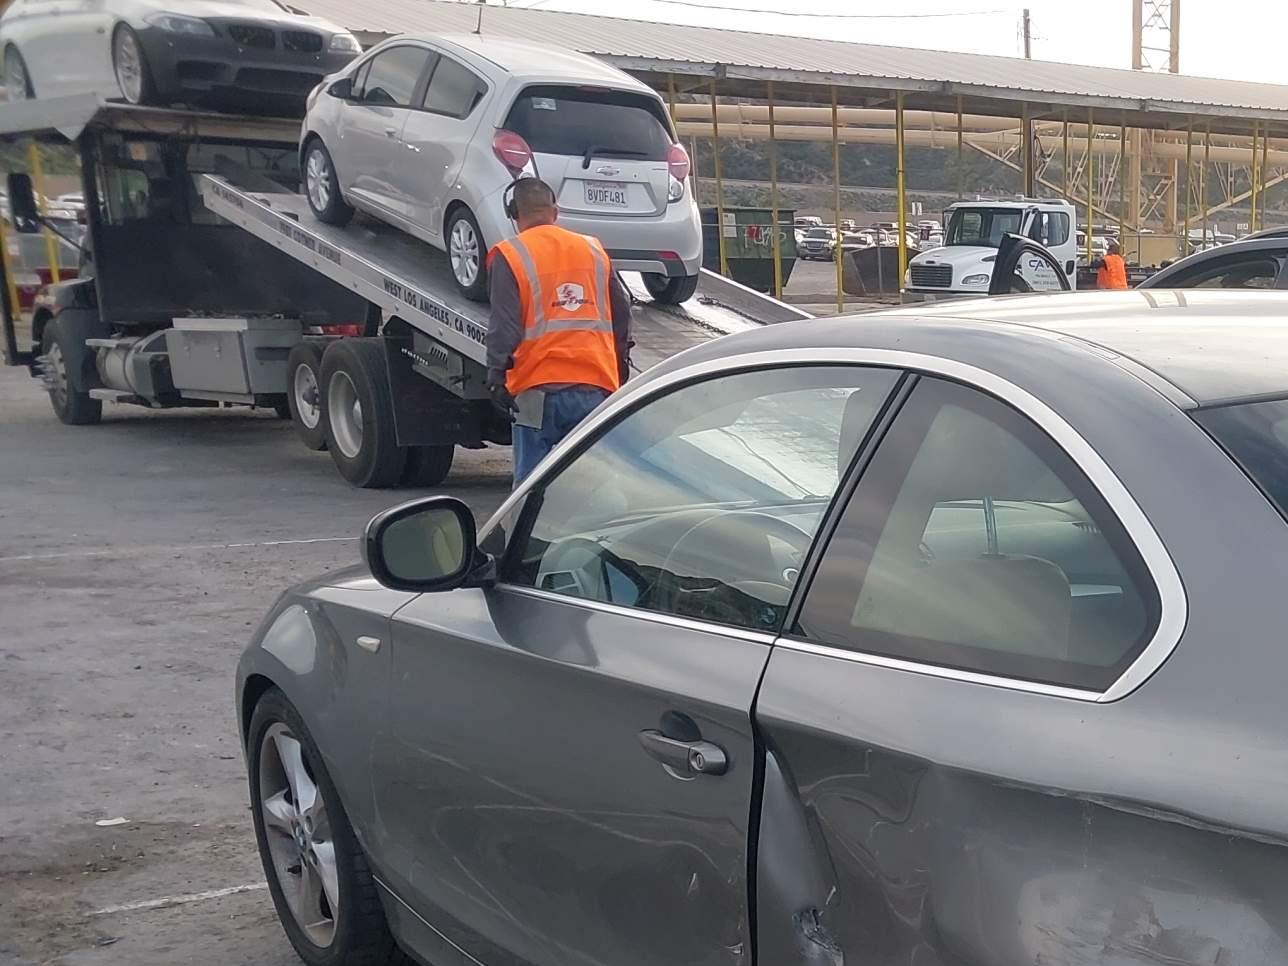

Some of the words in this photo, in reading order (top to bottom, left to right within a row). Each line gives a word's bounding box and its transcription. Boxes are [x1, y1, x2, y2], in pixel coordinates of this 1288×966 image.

[383, 278, 402, 298] WEST
[403, 289, 417, 307] LOS
[419, 298, 452, 327] ANGELES,
[454, 317, 464, 334] CA
[466, 324, 486, 345] 9002
